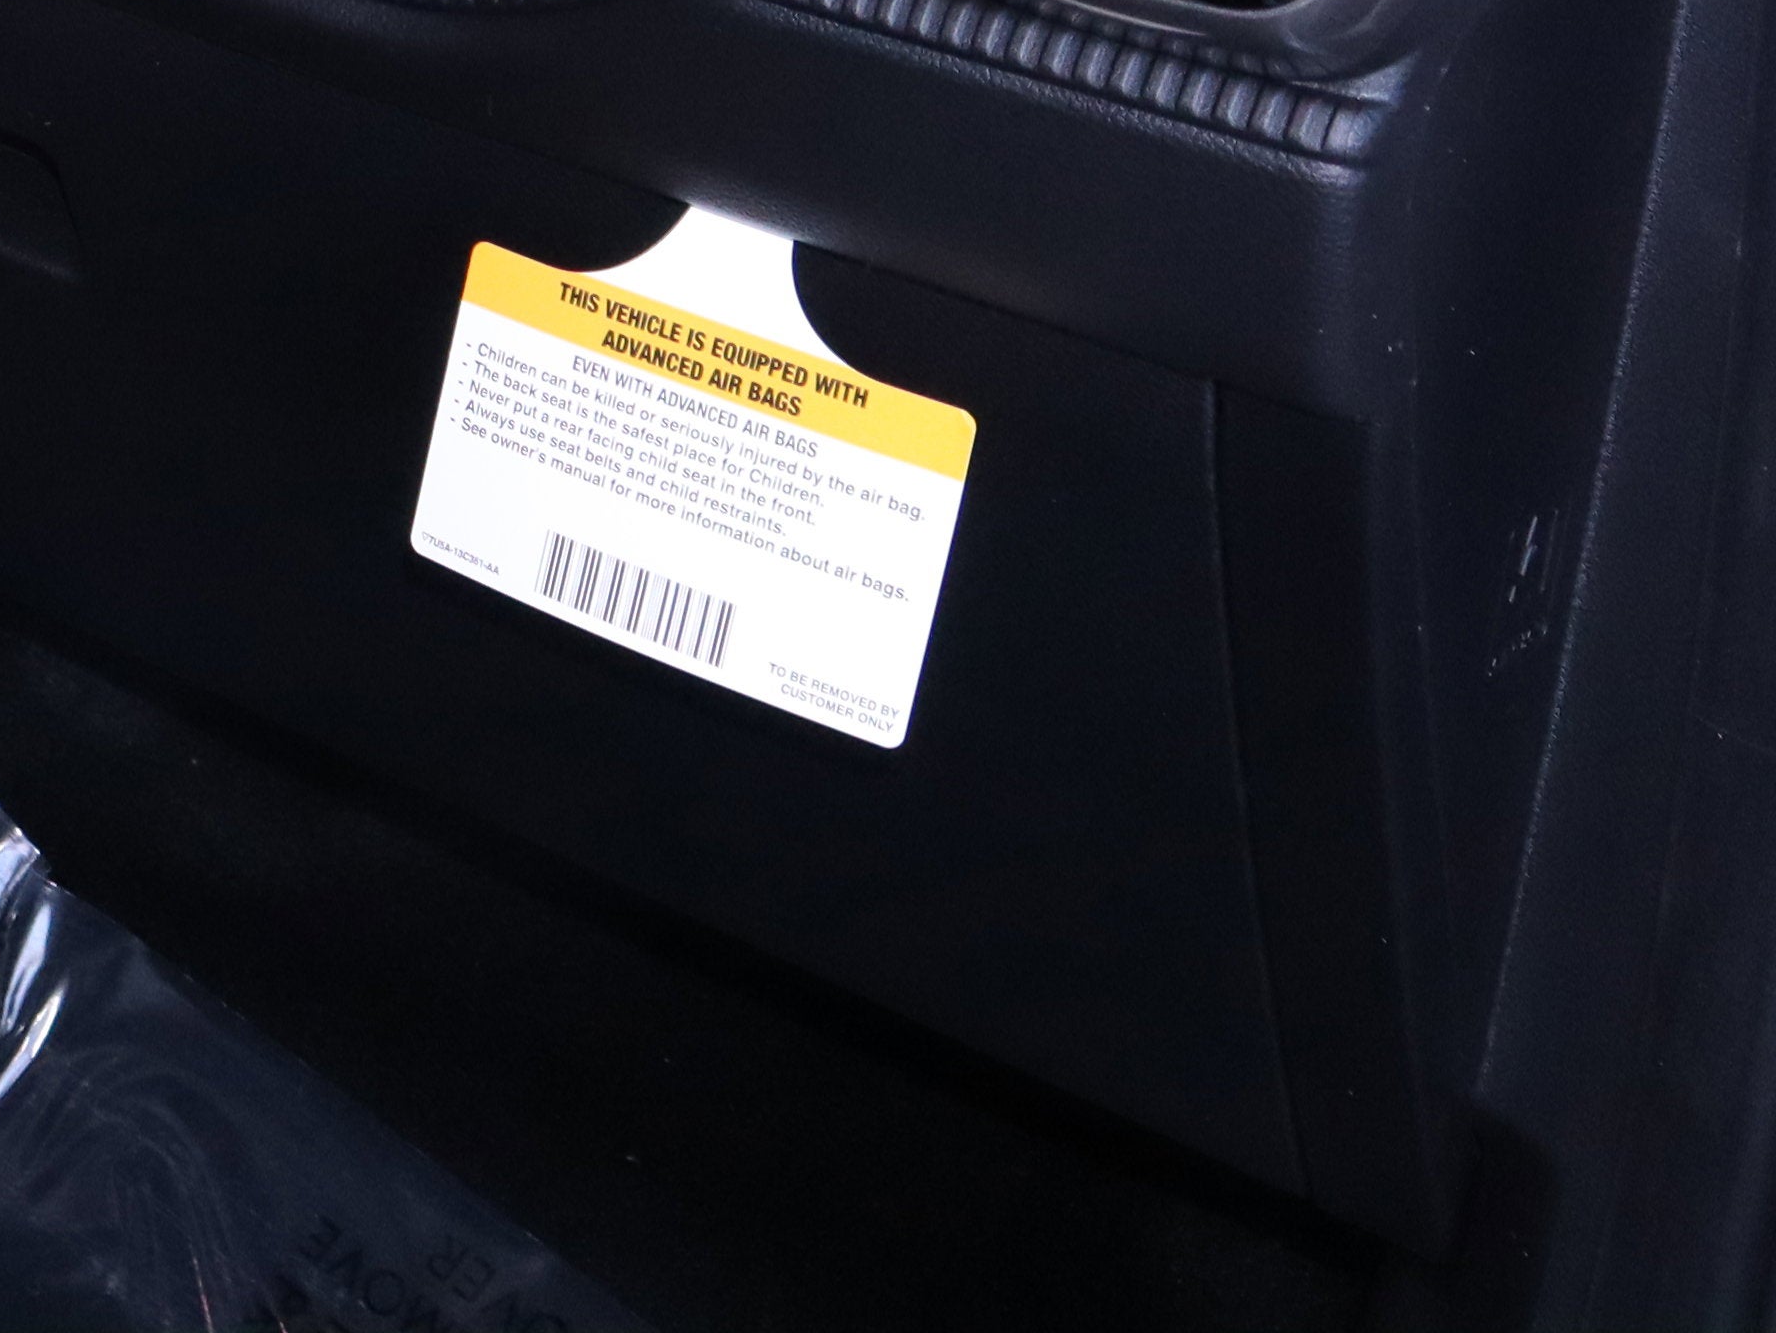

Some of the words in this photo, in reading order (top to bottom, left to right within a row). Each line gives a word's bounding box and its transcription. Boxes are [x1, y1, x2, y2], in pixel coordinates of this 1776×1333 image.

[560, 281, 600, 314] THIS
[605, 298, 683, 344] VEHICLE
[685, 328, 707, 352] IS
[710, 336, 809, 387] EQUIPPED
[815, 372, 869, 408] WITH
[572, 354, 611, 382] EVEN
[615, 370, 654, 398] WITH
[656, 388, 738, 429] ADVANCED
[741, 419, 770, 442] AIR
[774, 429, 818, 458] BAGS
[601, 329, 704, 381] ADVANCED
[707, 368, 743, 396] AIR
[747, 381, 802, 417] BAGS
[464, 399, 516, 431] Always
[519, 423, 546, 443] use
[549, 436, 581, 458] seat
[584, 447, 622, 474] belts
[625, 467, 657, 487] and
[659, 480, 700, 504] child
[703, 496, 786, 537] restraints.
[469, 379, 511, 407] Never
[512, 400, 538, 420] put
[540, 412, 550, 424] a
[553, 417, 584, 437] rear
[587, 427, 635, 461] facing
[638, 451, 679, 474] child
[681, 467, 716, 489] seat
[720, 478, 736, 496] in
[740, 486, 767, 507] the
[771, 497, 815, 526] front.
[474, 359, 500, 383] The
[503, 372, 538, 399] back
[540, 391, 573, 414] seat
[576, 403, 589, 419] is
[593, 410, 618, 430] the
[621, 423, 669, 451] safest
[672, 442, 717, 468] place
[721, 457, 745, 477] for
[749, 468, 824, 507] Children.
[477, 342, 537, 378] Children
[540, 371, 568, 390] can
[571, 380, 590, 399] be
[594, 388, 636, 416] killed
[639, 409, 657, 423] or
[660, 417, 735, 455] seriously
[738, 442, 798, 476] injured
[802, 465, 824, 487] by
[828, 475, 855, 496] the
[859, 489, 884, 505] air
[887, 495, 925, 522] bag.
[460, 416, 487, 439] See
[490, 432, 547, 465] owner's
[550, 457, 607, 488] manual
[609, 478, 632, 498] for
[635, 491, 676, 516] more
[680, 506, 775, 554] information
[779, 546, 830, 574] about
[833, 565, 858, 582] air
[861, 572, 909, 602] bags.
[769, 661, 787, 678] TO
[789, 670, 809, 687] BE
[810, 678, 878, 712] REMOVED
[880, 703, 900, 720] BY
[780, 683, 855, 719] CUSTOMER
[857, 712, 894, 733] ONLY
